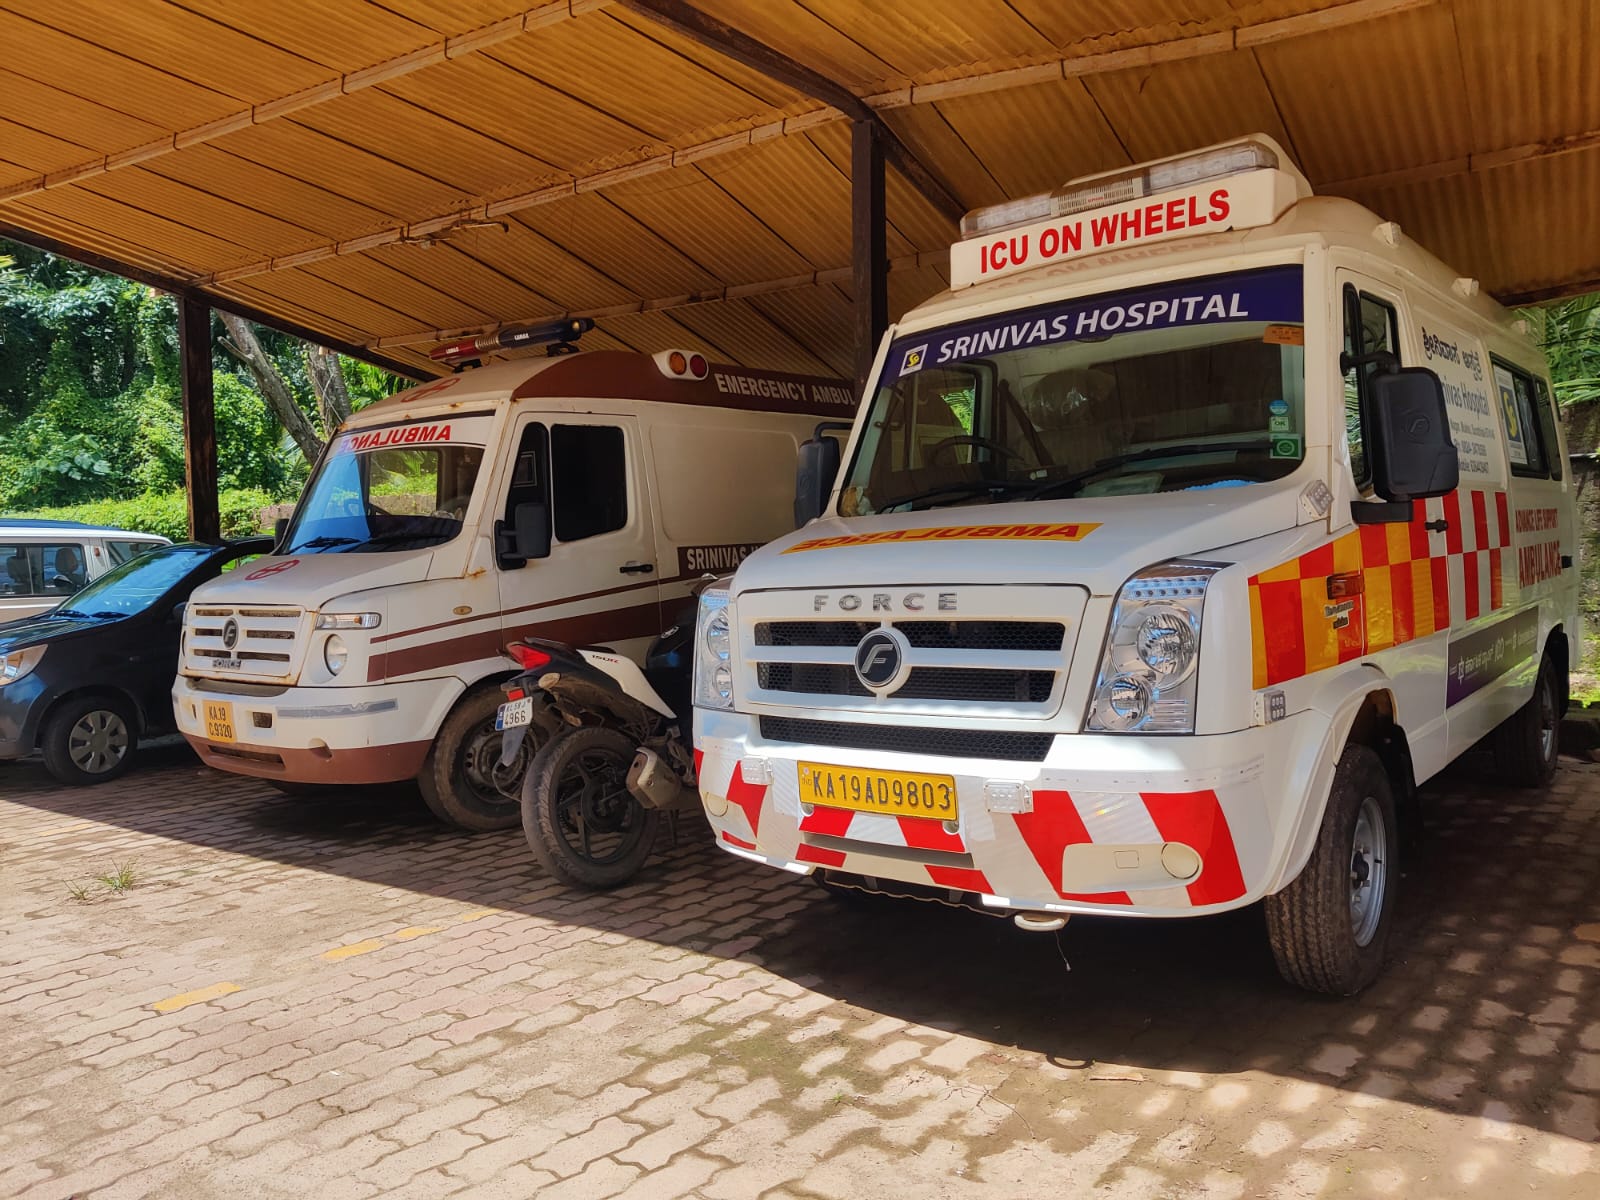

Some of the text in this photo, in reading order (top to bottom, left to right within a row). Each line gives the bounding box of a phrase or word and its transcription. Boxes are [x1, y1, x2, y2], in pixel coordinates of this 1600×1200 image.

[980, 189, 1231, 274] ICU ON WHEELS
[936, 293, 1249, 363] SRINIVAS HOSPITAL
[714, 373, 855, 406] EMERGENCY AMBUL
[687, 545, 747, 571] SRINIVAS
[1518, 540, 1561, 590] AMBULANCE
[813, 592, 958, 612] FORCE
[504, 710, 526, 725] 4966
[812, 769, 951, 811] KA19AD9803
